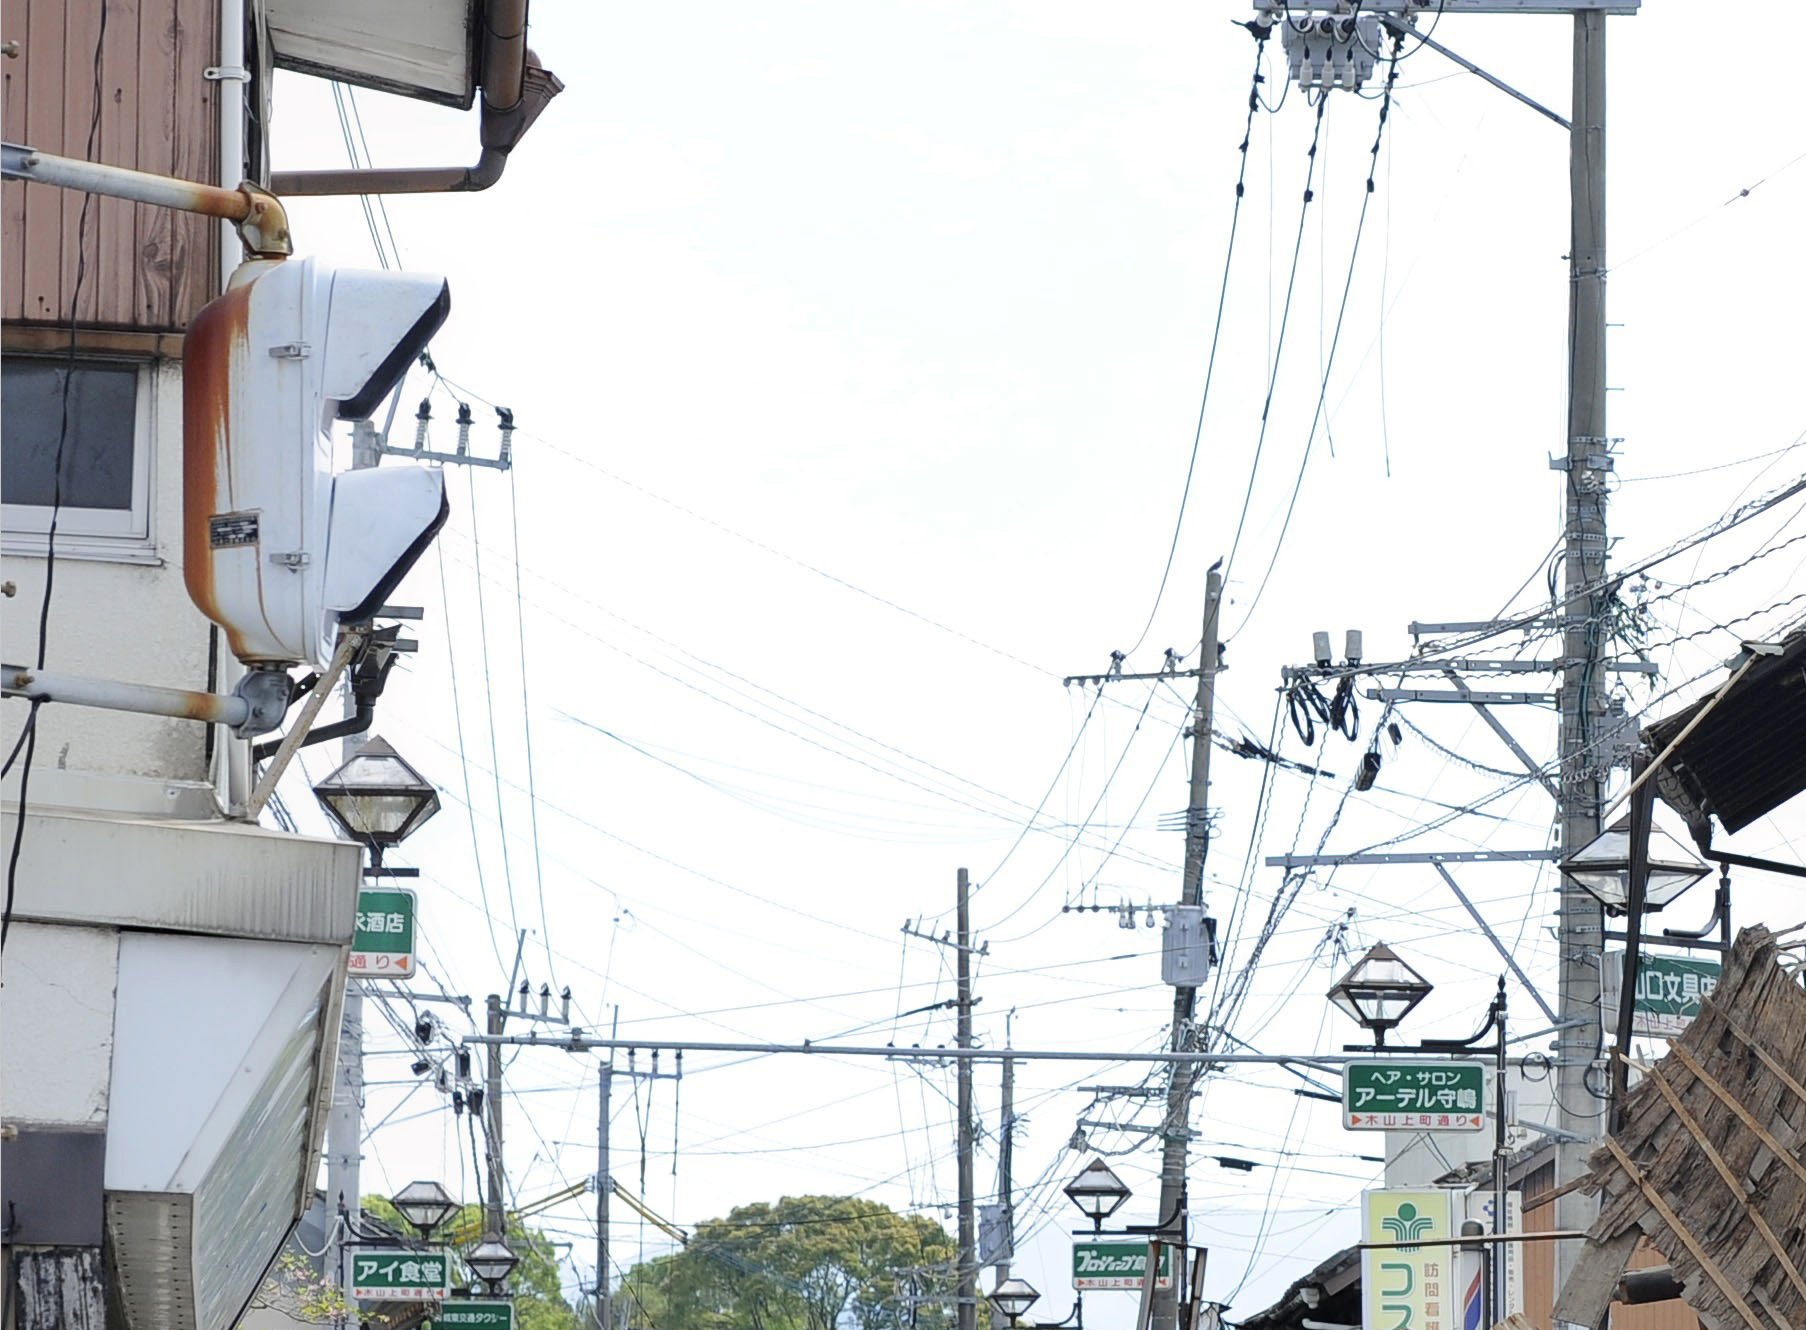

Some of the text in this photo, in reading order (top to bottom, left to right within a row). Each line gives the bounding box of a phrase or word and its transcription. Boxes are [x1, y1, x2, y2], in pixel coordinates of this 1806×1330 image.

[1370, 1070, 1462, 1086] ヘア・サロン
[1365, 1115, 1468, 1127] 木山上町通り
[357, 1260, 443, 1283] アイ食堂
